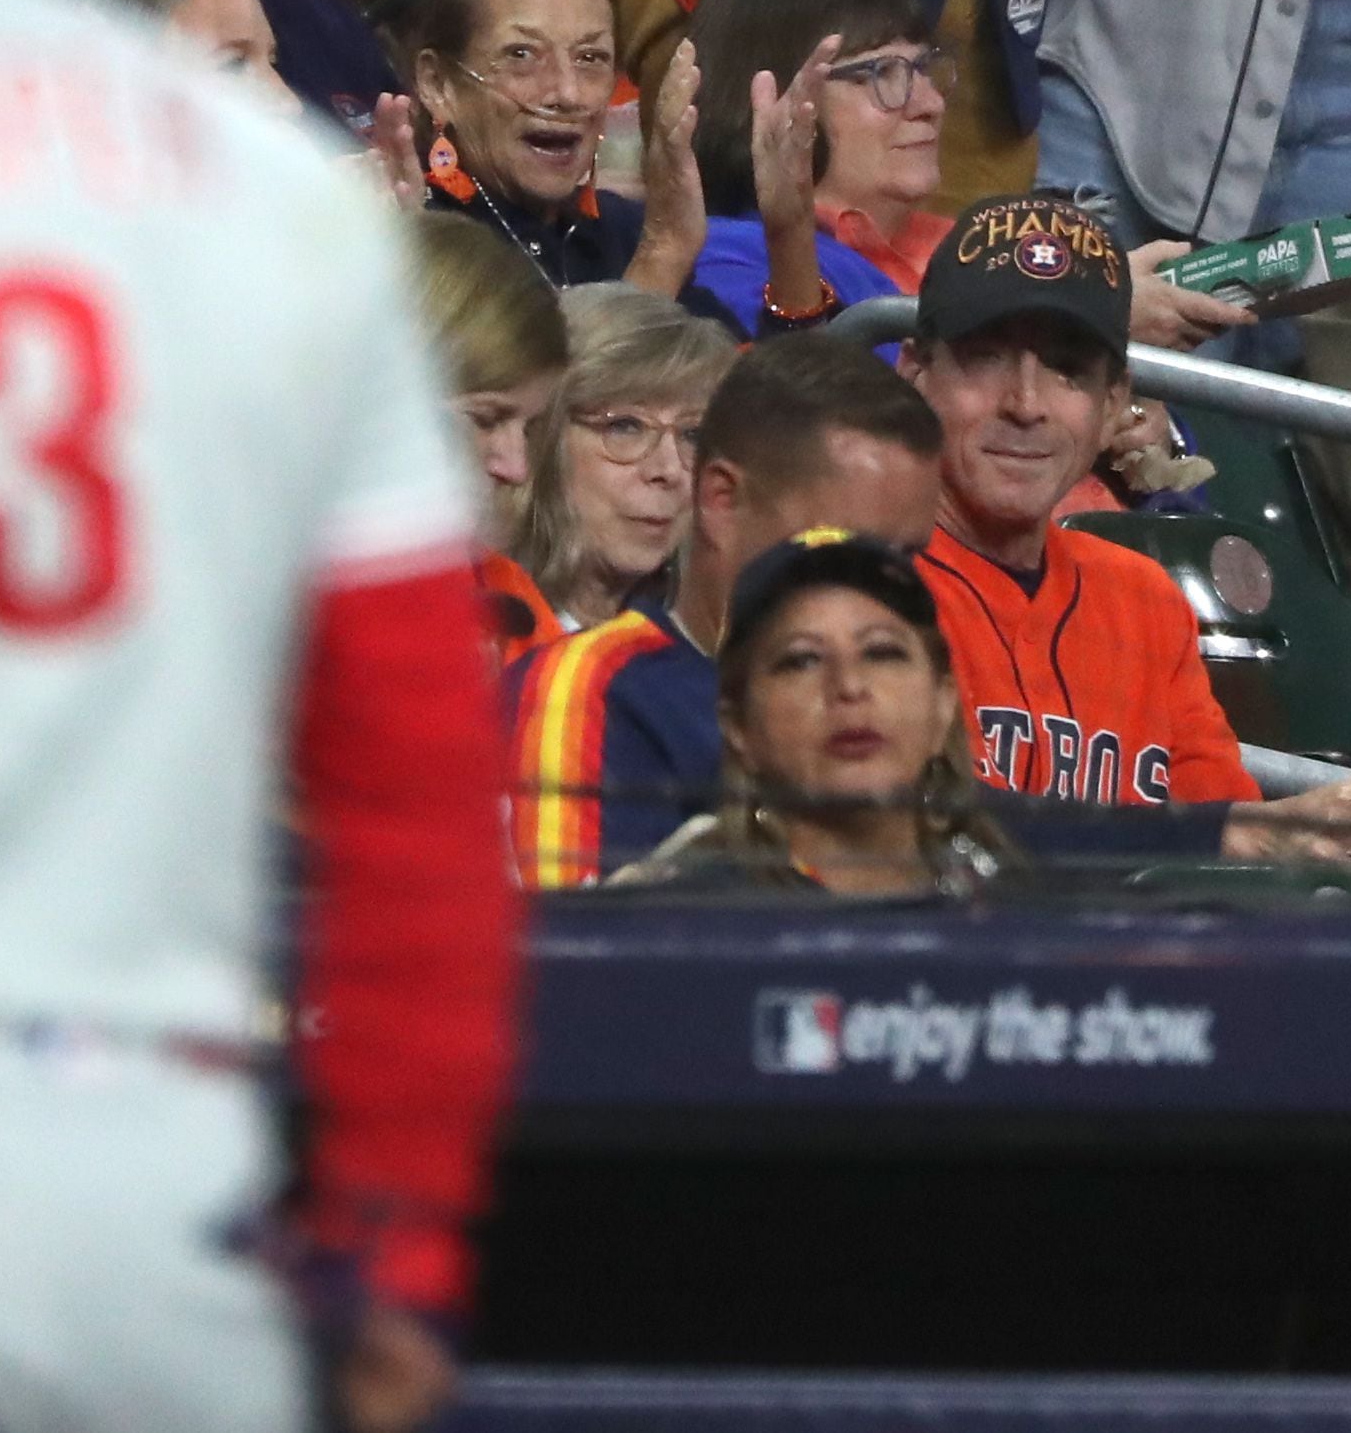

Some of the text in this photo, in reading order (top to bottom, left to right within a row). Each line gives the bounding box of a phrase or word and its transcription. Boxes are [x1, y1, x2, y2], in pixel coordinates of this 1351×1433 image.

[958, 211, 1121, 290] CHAMPS
[972, 200, 1049, 224] WORLD
[1257, 239, 1298, 267] PAPA
[976, 705, 1170, 805] TROS
[845, 980, 983, 1083] enjoy
[985, 983, 1071, 1062] the
